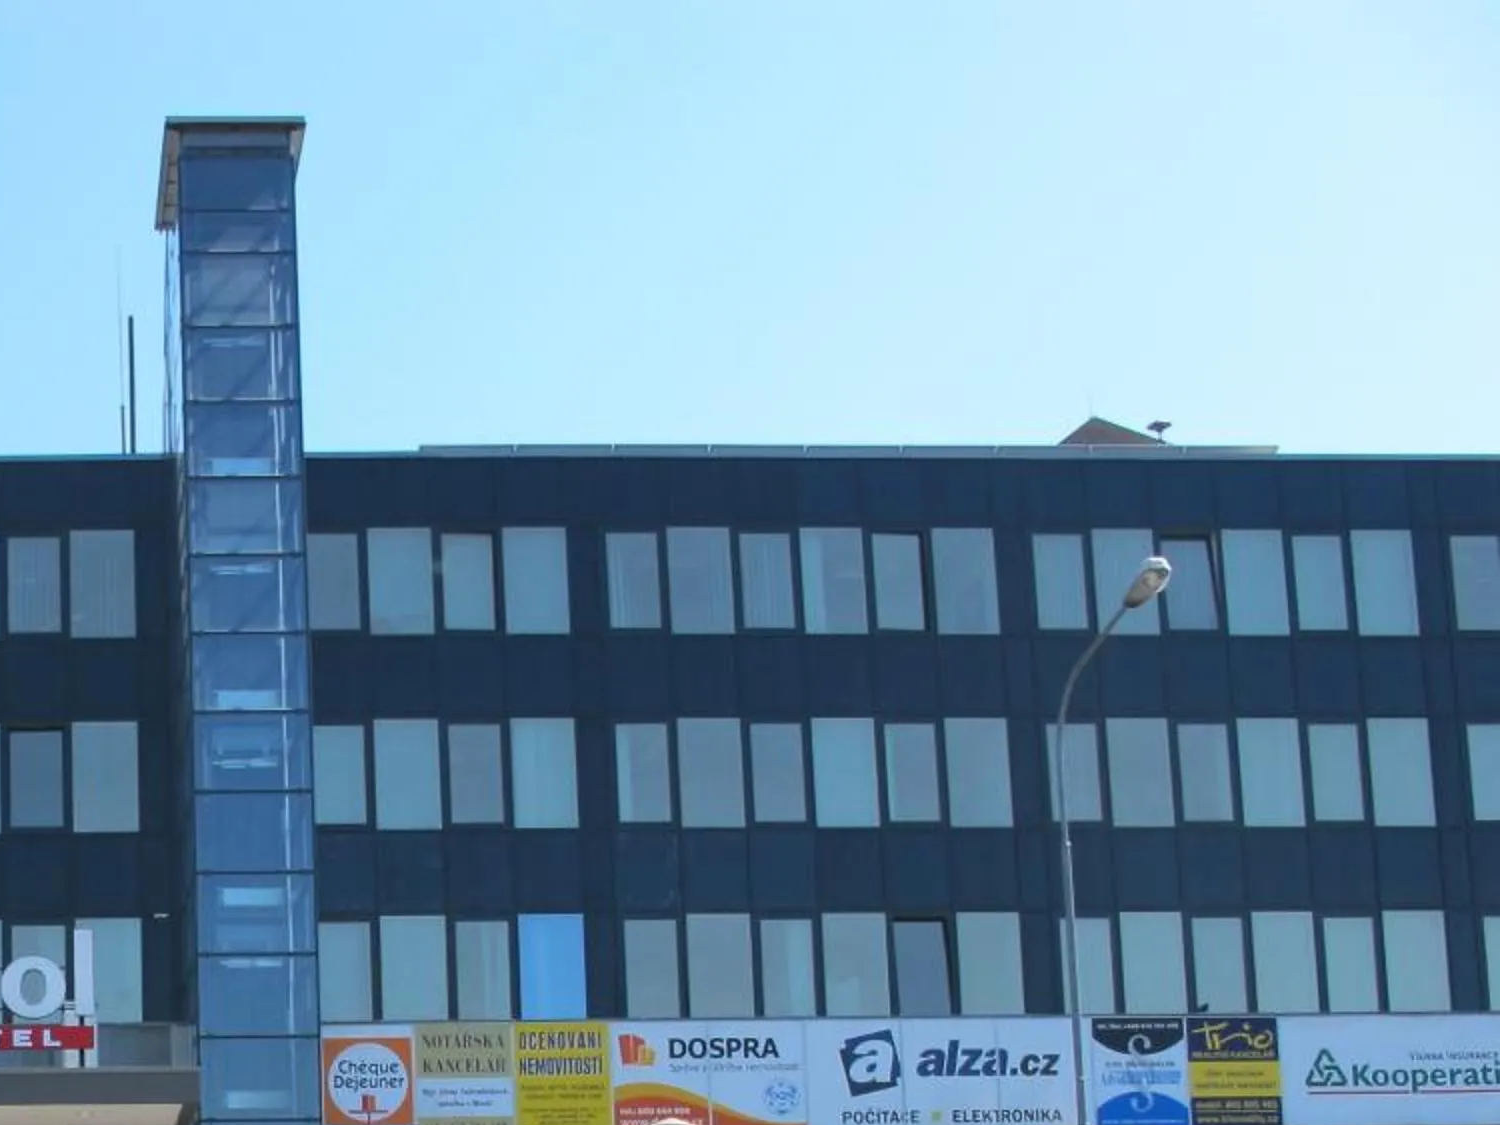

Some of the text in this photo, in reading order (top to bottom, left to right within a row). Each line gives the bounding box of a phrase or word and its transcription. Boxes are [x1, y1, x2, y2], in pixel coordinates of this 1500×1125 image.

[669, 1037, 780, 1059] DOSPRA
[916, 1040, 1060, 1077] alza.cz
[952, 1108, 1063, 1123] ELEKTRONIKA
